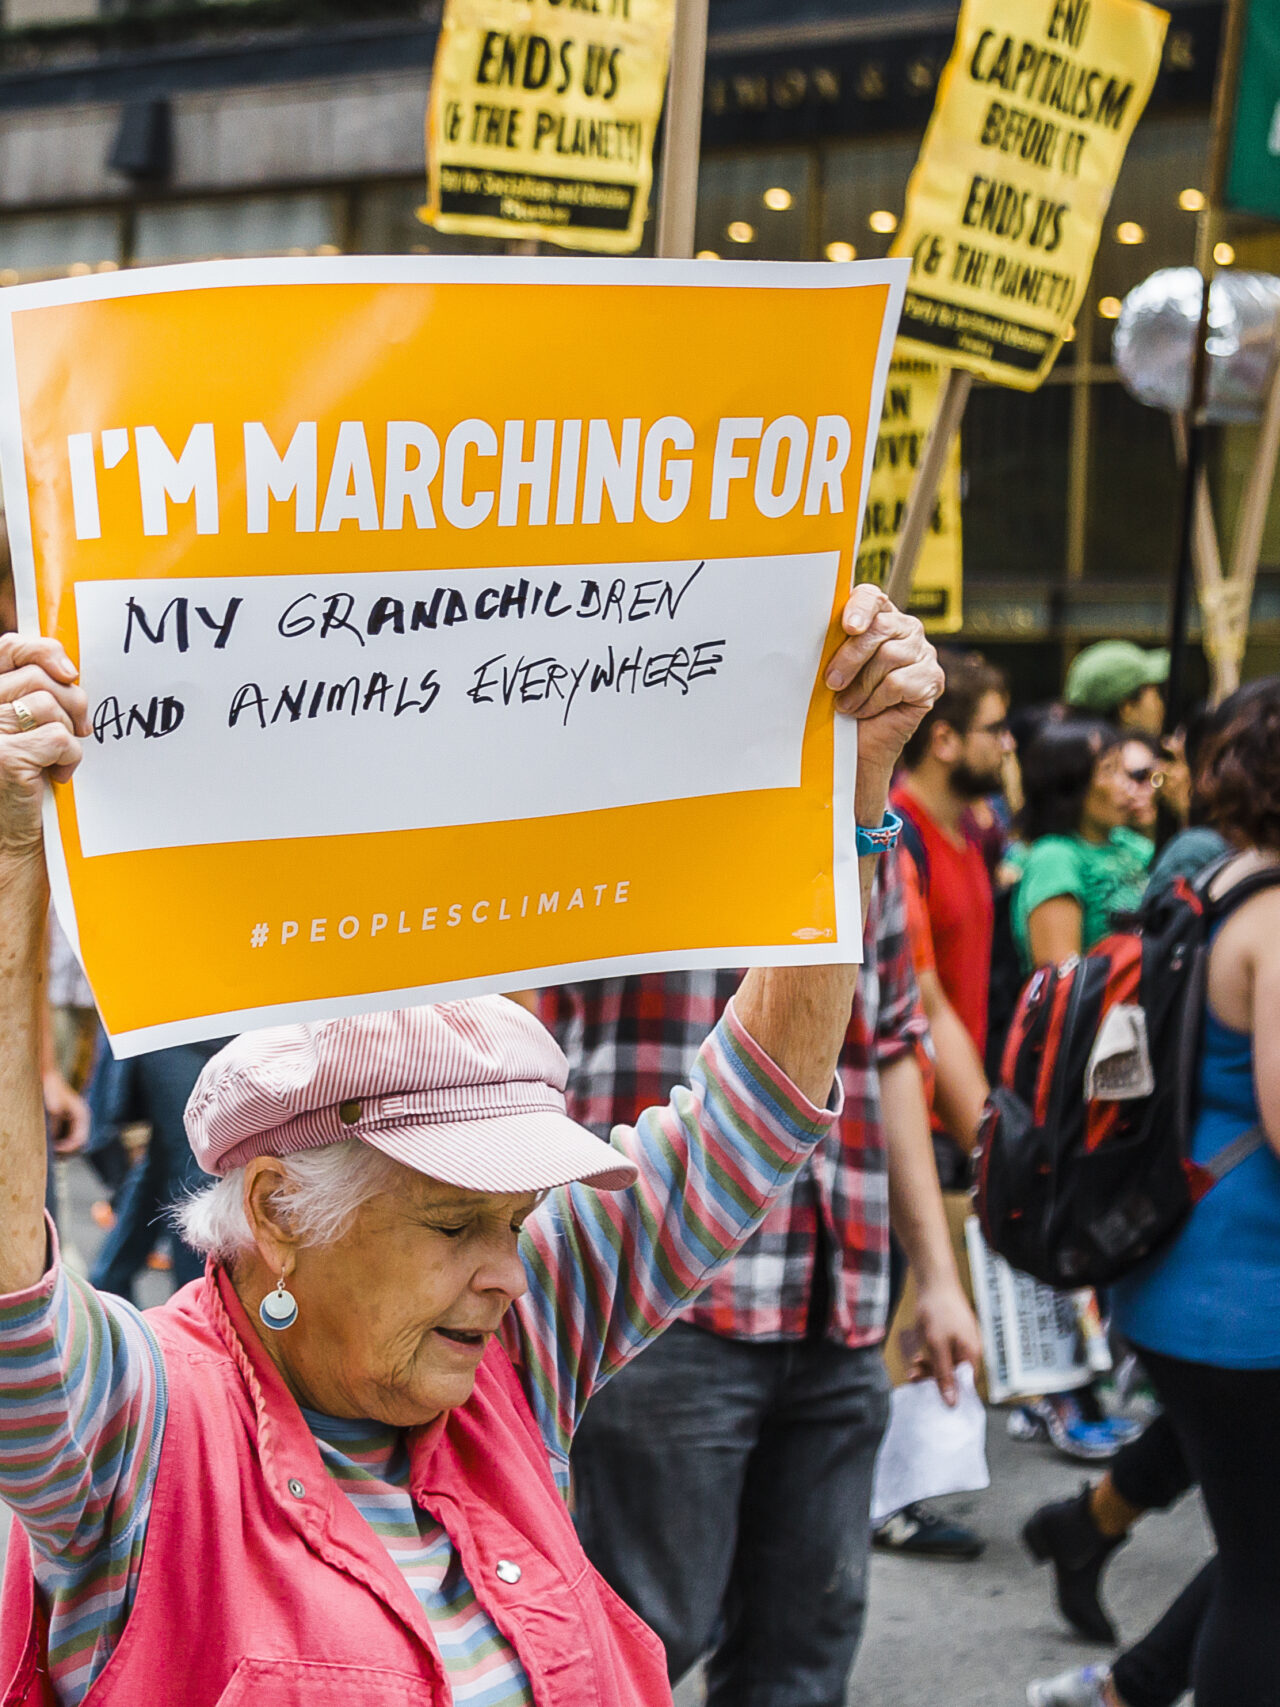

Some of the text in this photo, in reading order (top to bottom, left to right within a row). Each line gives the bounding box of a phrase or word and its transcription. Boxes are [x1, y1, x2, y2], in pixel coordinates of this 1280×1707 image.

[476, 31, 623, 100] ENDS US
[971, 29, 1133, 130] CAPITALISM
[472, 103, 521, 148] THE
[1061, 130, 1089, 177] IT
[962, 175, 1070, 251] ENDS US
[67, 414, 851, 541] I'M MARCHING FOR
[124, 560, 705, 653] MY GRANDCHILDREN
[92, 638, 727, 744] AND ANIMALS EVERYWHERE
[249, 880, 631, 949] #PEOPLESCLIMATE
